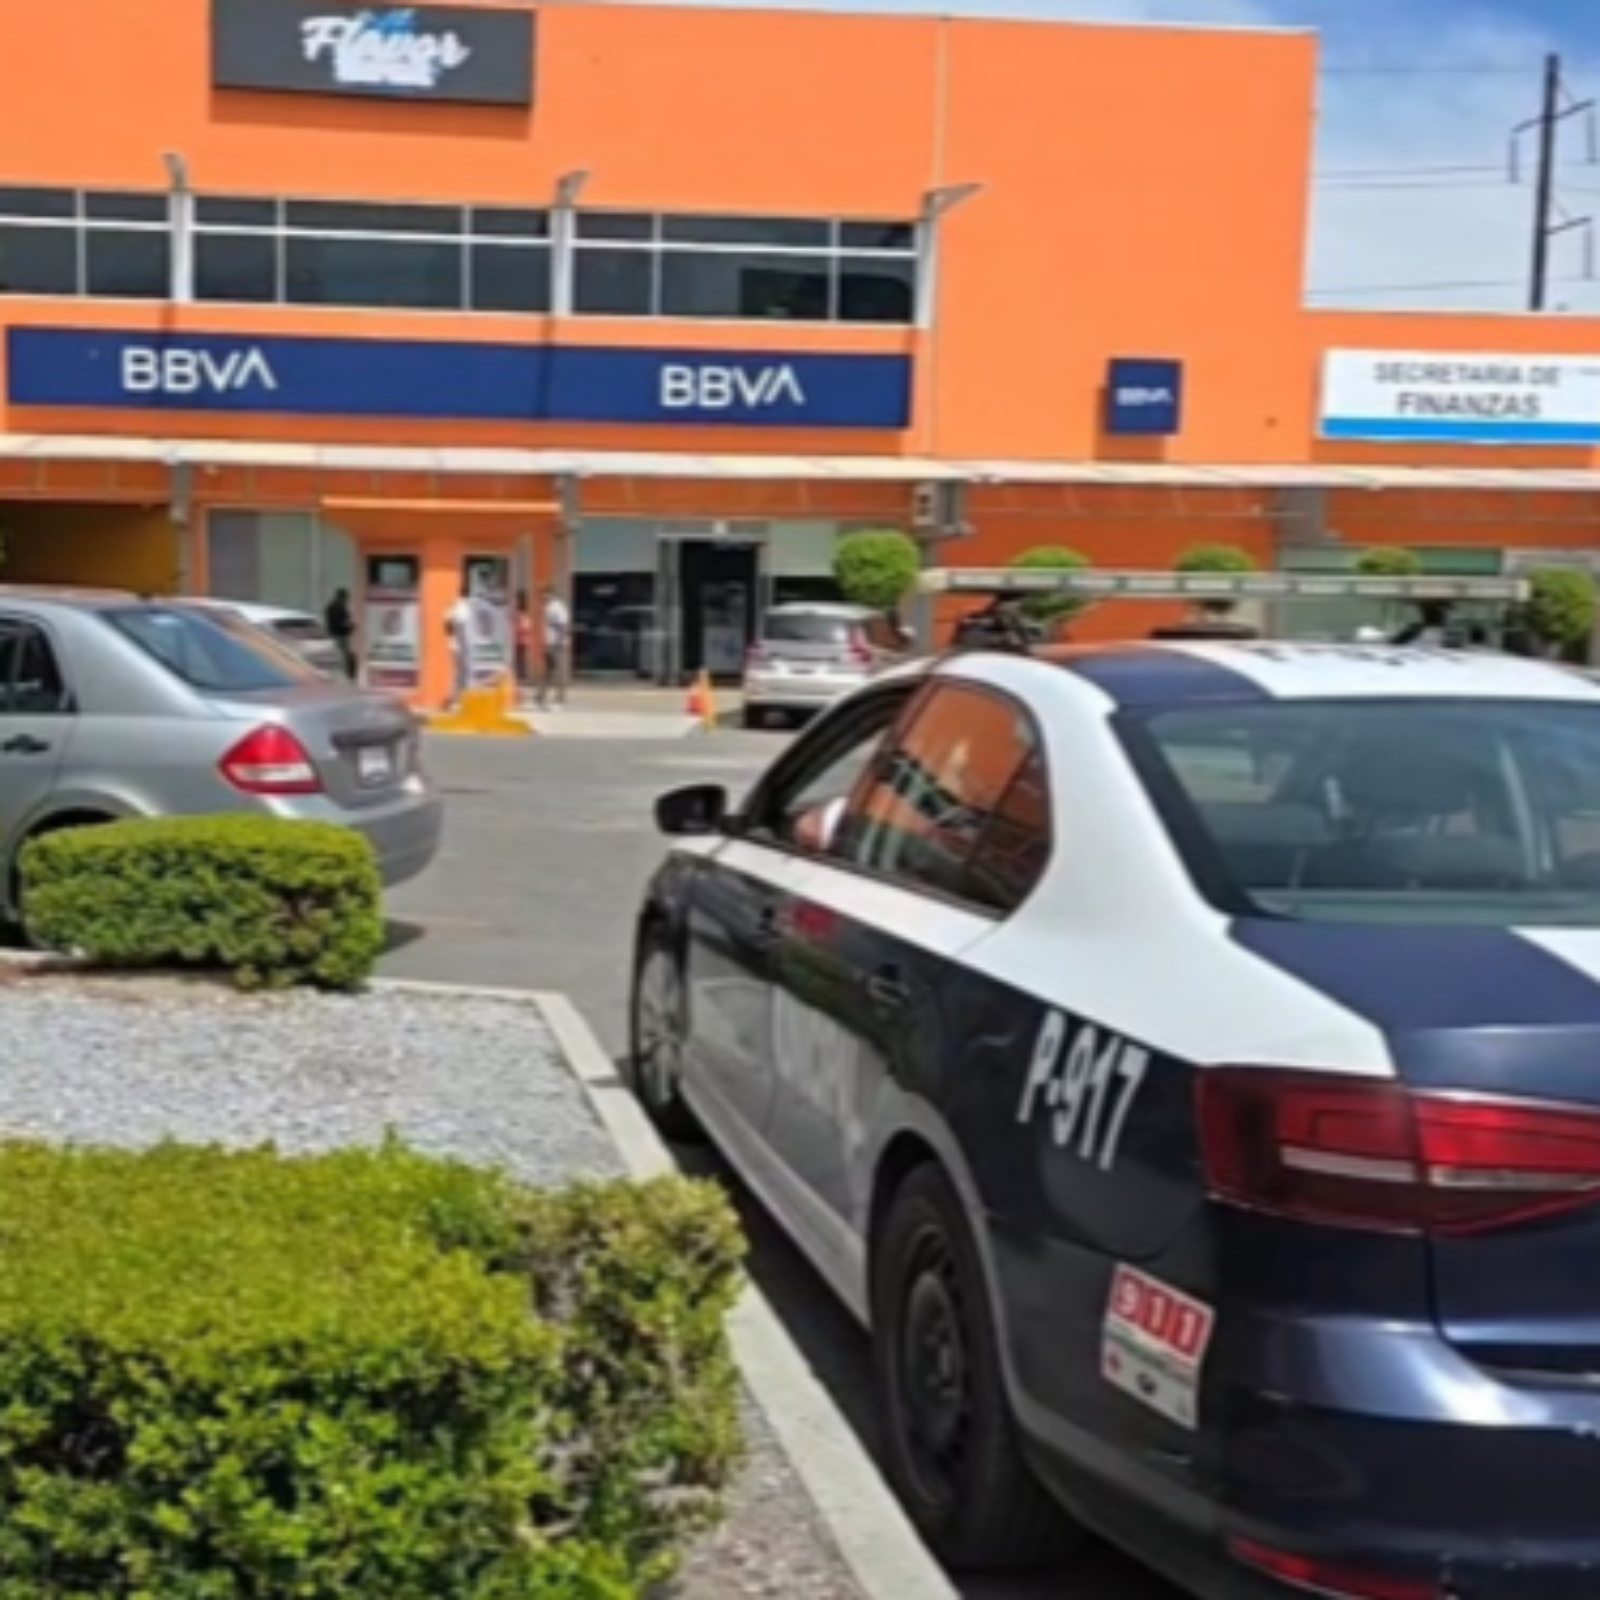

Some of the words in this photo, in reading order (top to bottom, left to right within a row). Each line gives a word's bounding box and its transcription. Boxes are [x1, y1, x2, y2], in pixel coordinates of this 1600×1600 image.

[121, 346, 278, 393] BBVA
[1530, 364, 1560, 387] DE
[660, 364, 805, 408] BBVA
[1117, 387, 1174, 406] BBVA
[1396, 390, 1542, 417] FINANZAS
